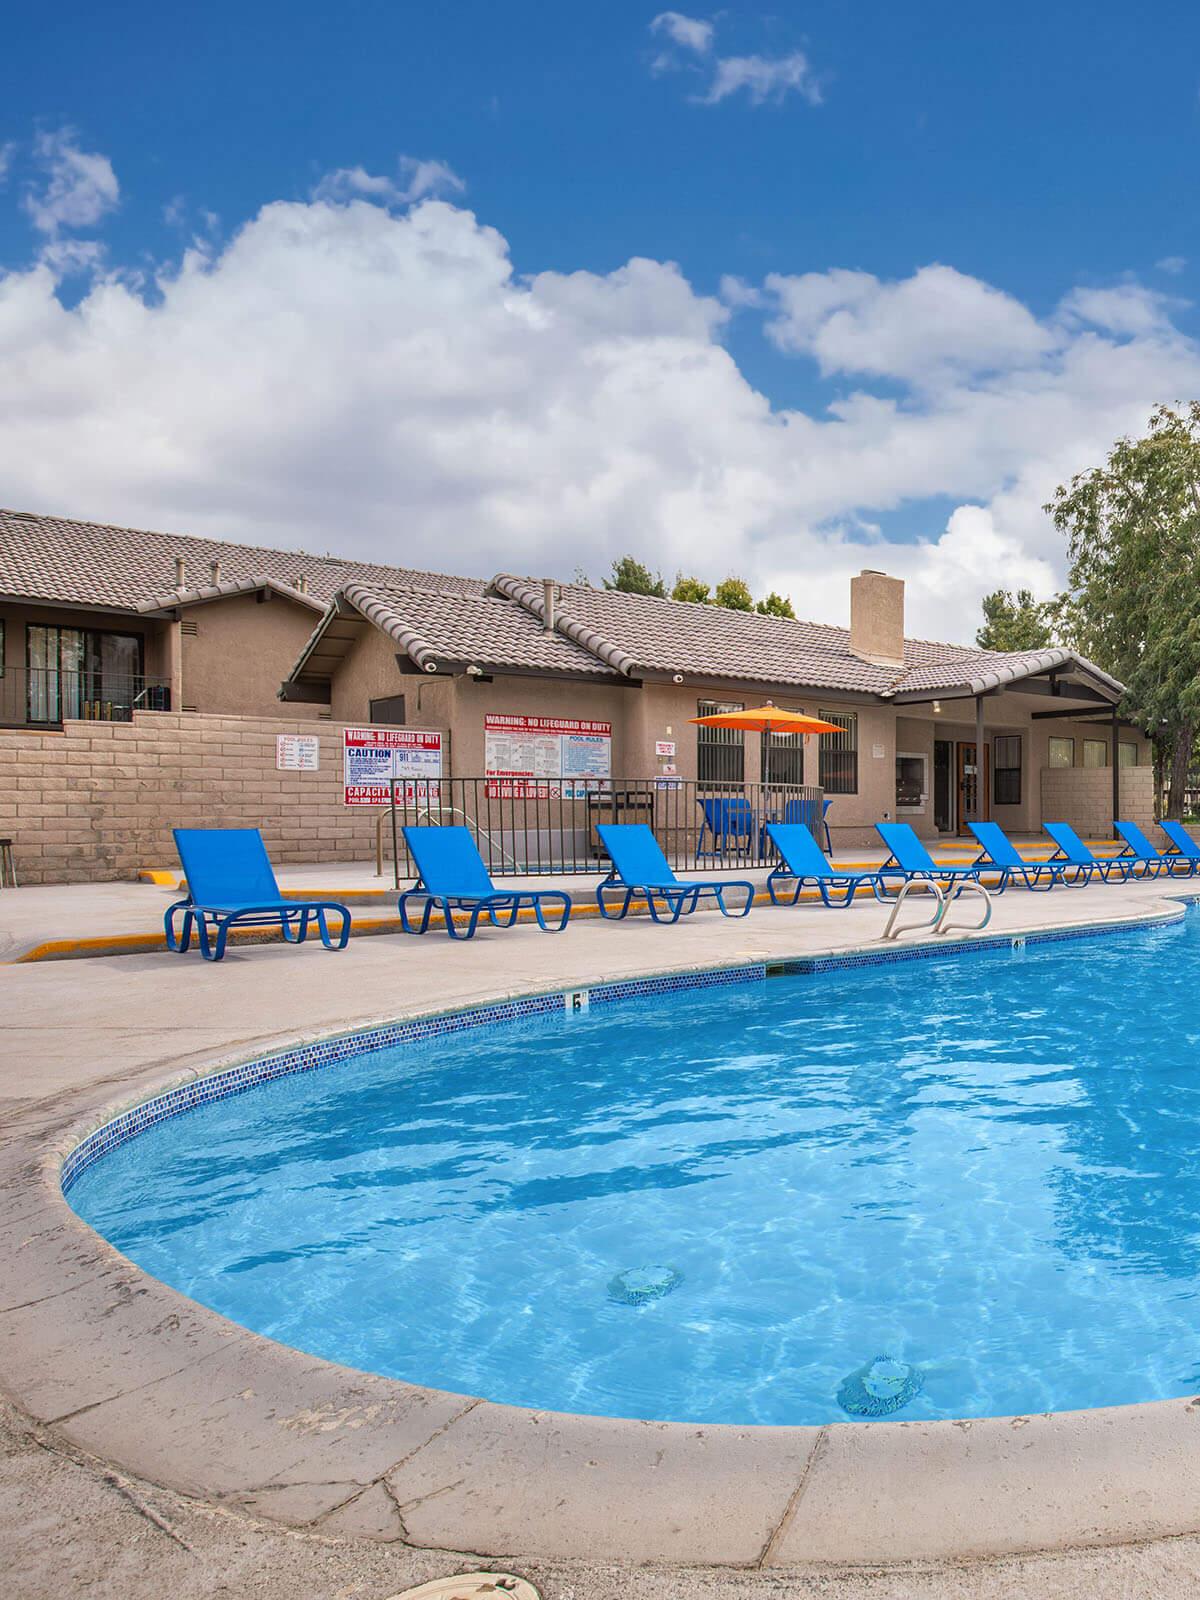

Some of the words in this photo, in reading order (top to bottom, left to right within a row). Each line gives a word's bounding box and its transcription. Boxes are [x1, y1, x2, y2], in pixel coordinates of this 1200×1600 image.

[486, 715, 527, 726] WARNING:
[527, 718, 539, 727] NO
[540, 718, 580, 729] LIFEGUARD
[580, 721, 591, 730] ON
[592, 721, 611, 732] DUTY
[377, 731, 385, 742] NO
[386, 732, 415, 743] LIFEGUARD
[416, 734, 424, 743] ON
[424, 734, 439, 744] DUTY
[348, 748, 392, 758] CAUTION
[399, 753, 409, 762] 911
[347, 787, 392, 797] CAPACITY
